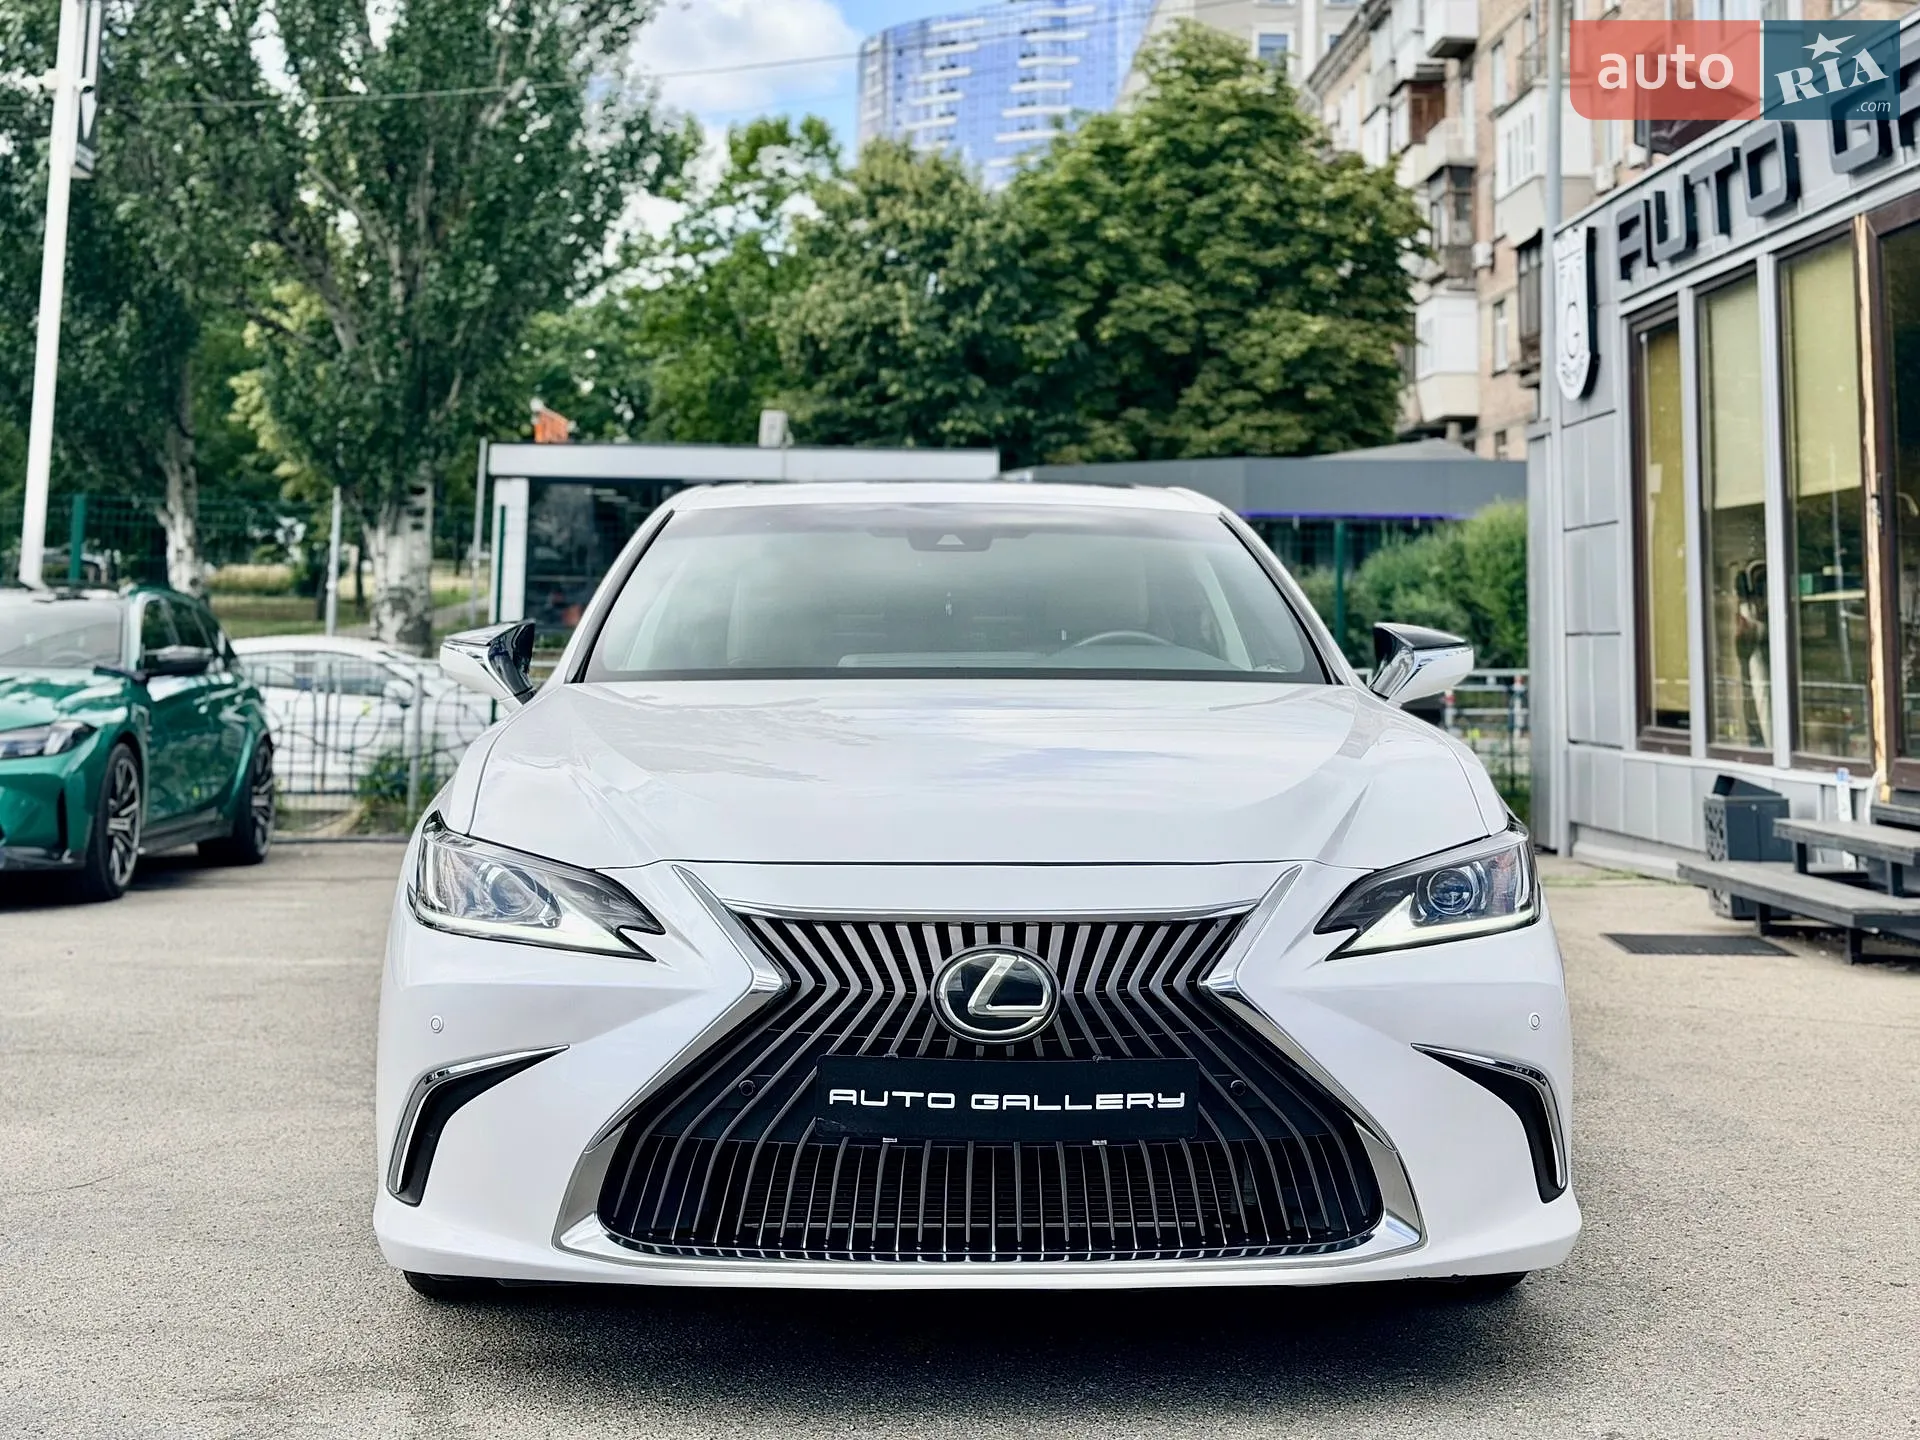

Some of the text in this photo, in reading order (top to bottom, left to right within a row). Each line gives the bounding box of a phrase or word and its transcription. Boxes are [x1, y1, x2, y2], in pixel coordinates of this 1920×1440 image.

[1616, 119, 1801, 280] AUTO
[829, 1089, 1185, 1111] AUTO GALLERY
